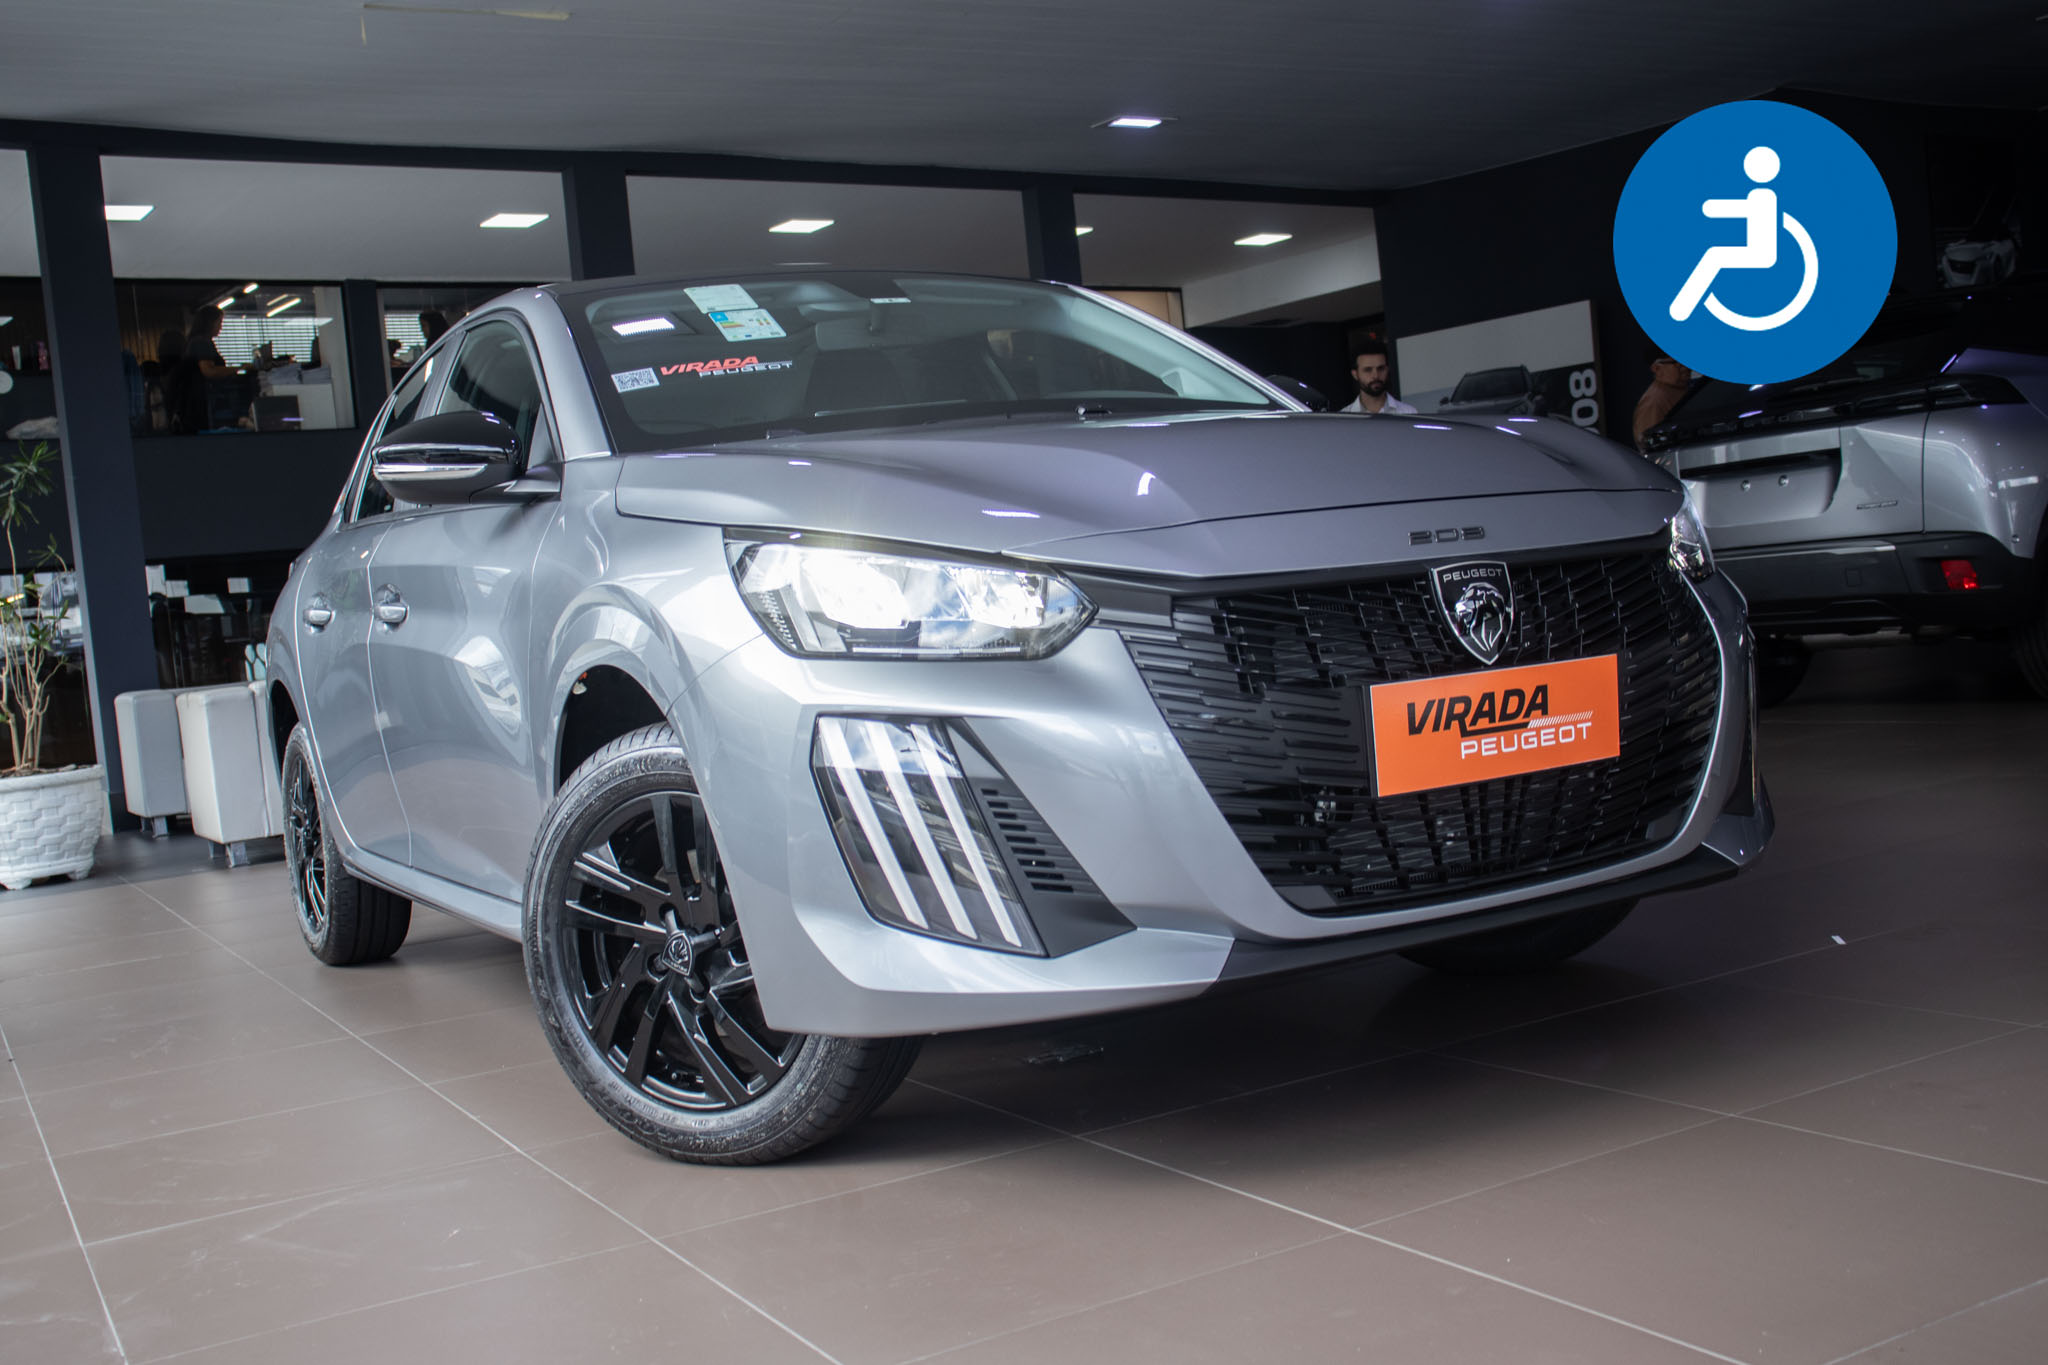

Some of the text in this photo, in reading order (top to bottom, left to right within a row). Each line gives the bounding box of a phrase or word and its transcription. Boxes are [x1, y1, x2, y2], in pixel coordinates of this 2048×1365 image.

[659, 355, 759, 376] VIRADA
[698, 361, 793, 378] PEUGEOT
[1568, 368, 1600, 434] 08
[1408, 526, 1486, 546] 208
[1442, 567, 1502, 583] PEUGEOT
[1406, 683, 1549, 738] VIRADA
[1460, 722, 1593, 760] PEUGEOT
